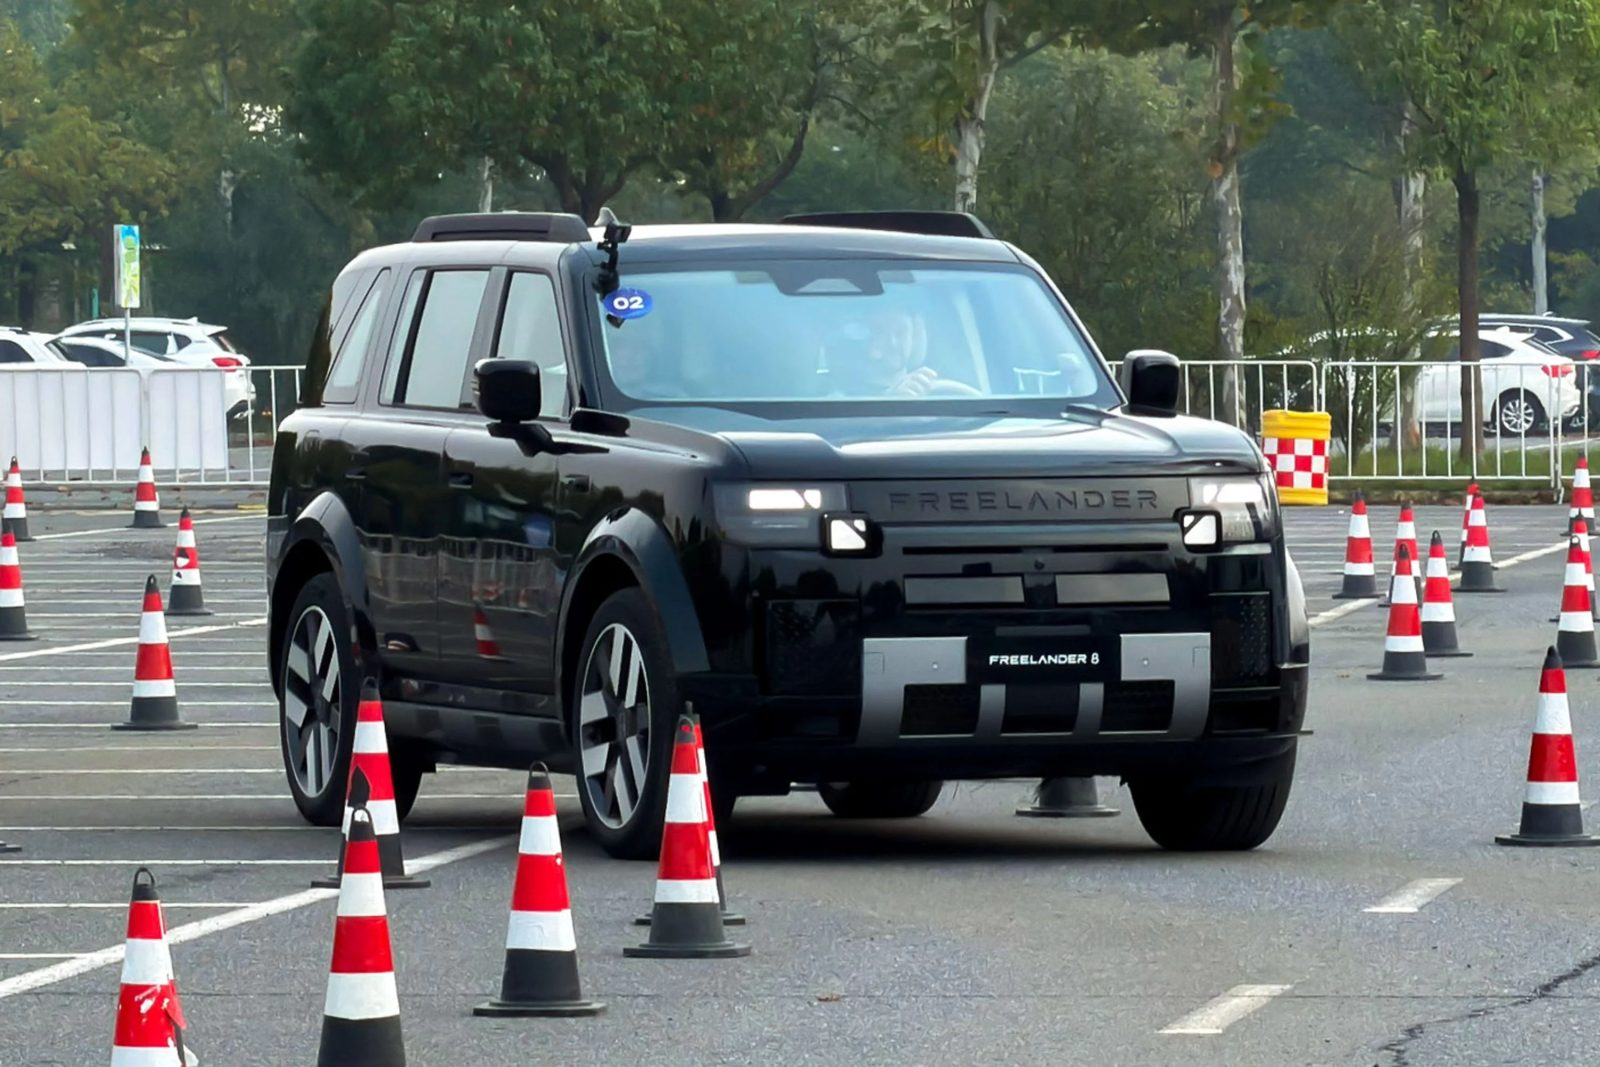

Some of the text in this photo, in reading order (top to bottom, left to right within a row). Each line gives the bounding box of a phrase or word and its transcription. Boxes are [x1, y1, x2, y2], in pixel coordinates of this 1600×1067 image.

[612, 295, 645, 310] 02
[888, 489, 1159, 513] FREELANDER
[988, 651, 1100, 666] FREELANDER 8
